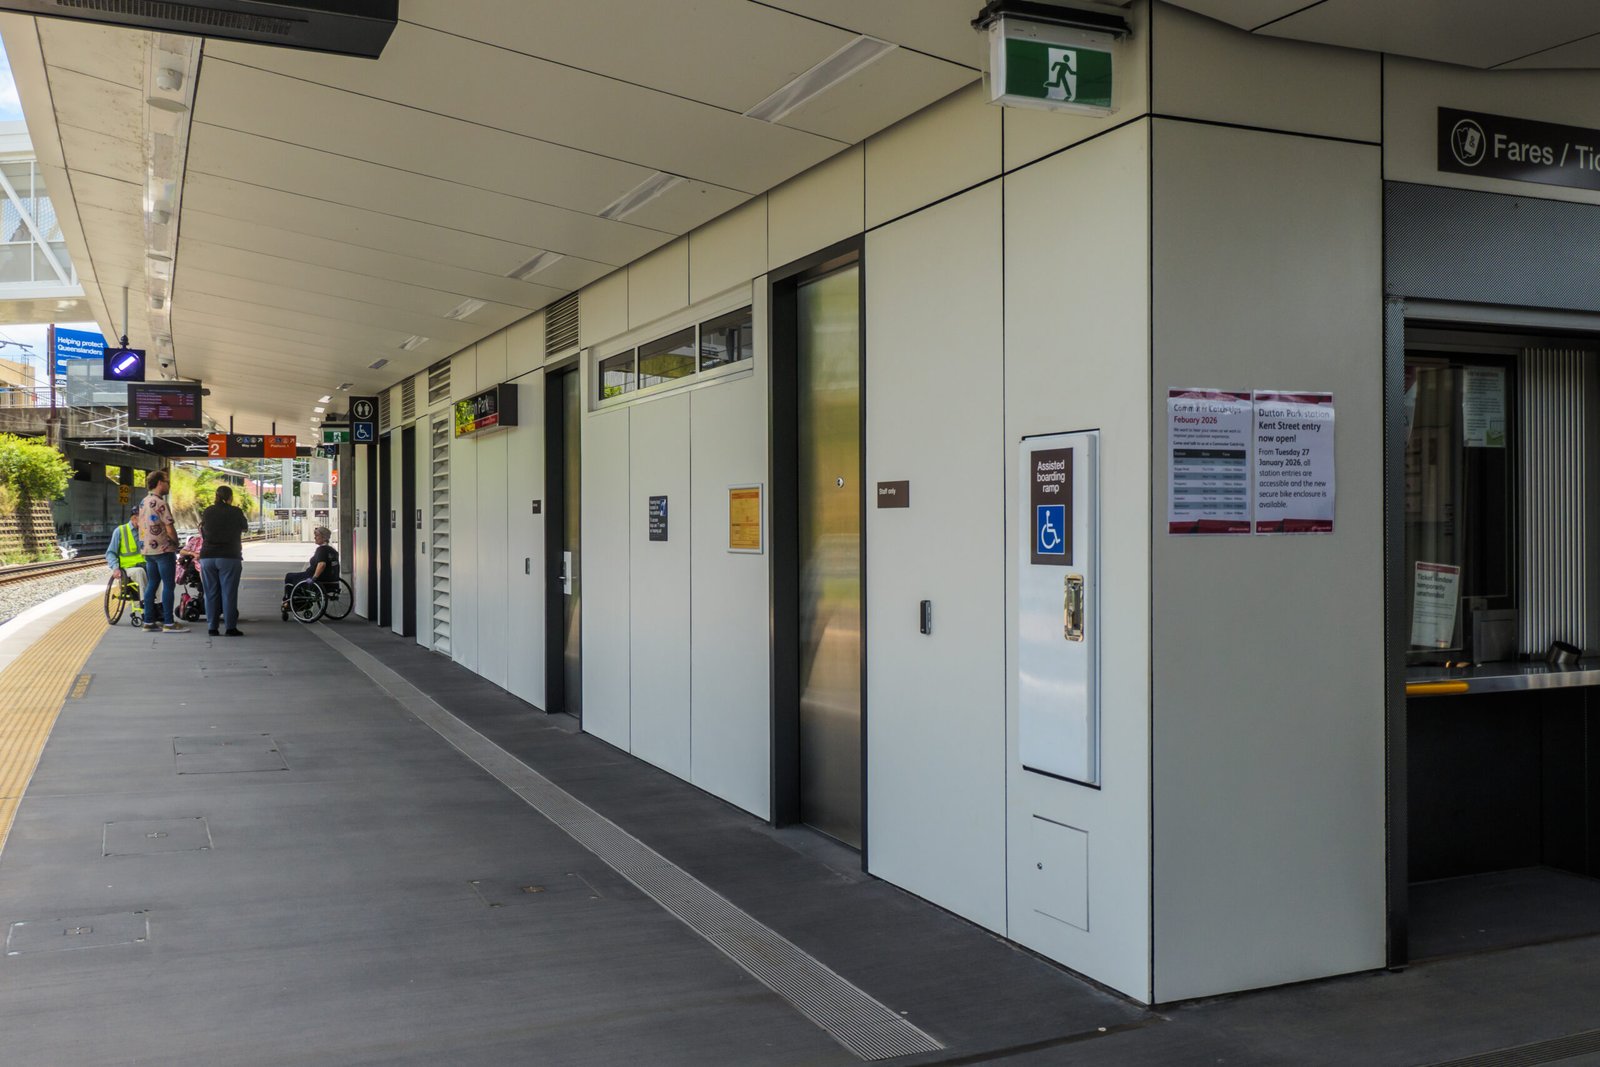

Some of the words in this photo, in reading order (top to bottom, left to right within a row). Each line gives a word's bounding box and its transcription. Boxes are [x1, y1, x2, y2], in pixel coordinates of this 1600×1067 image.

[1494, 133, 1554, 166] Fares
[1560, 142, 1569, 168] /
[57, 337, 80, 346] Helping
[57, 344, 103, 355] Queenslanders
[1259, 409, 1284, 418] Dutton
[1287, 410, 1301, 418] Park
[1174, 416, 1200, 425] Febuary
[1259, 422, 1276, 430] Kent
[1278, 422, 1300, 430] Street
[1302, 423, 1321, 432] entry
[1276, 435, 1296, 444] open!
[210, 444, 219, 456] 2
[1275, 449, 1300, 457] Tuesday
[1037, 460, 1065, 471] Assisted
[1259, 459, 1284, 467] January
[331, 476, 337, 484] 2
[1037, 471, 1065, 483] boarding
[1042, 484, 1059, 494] ramp
[1417, 583, 1446, 592] temporarily
